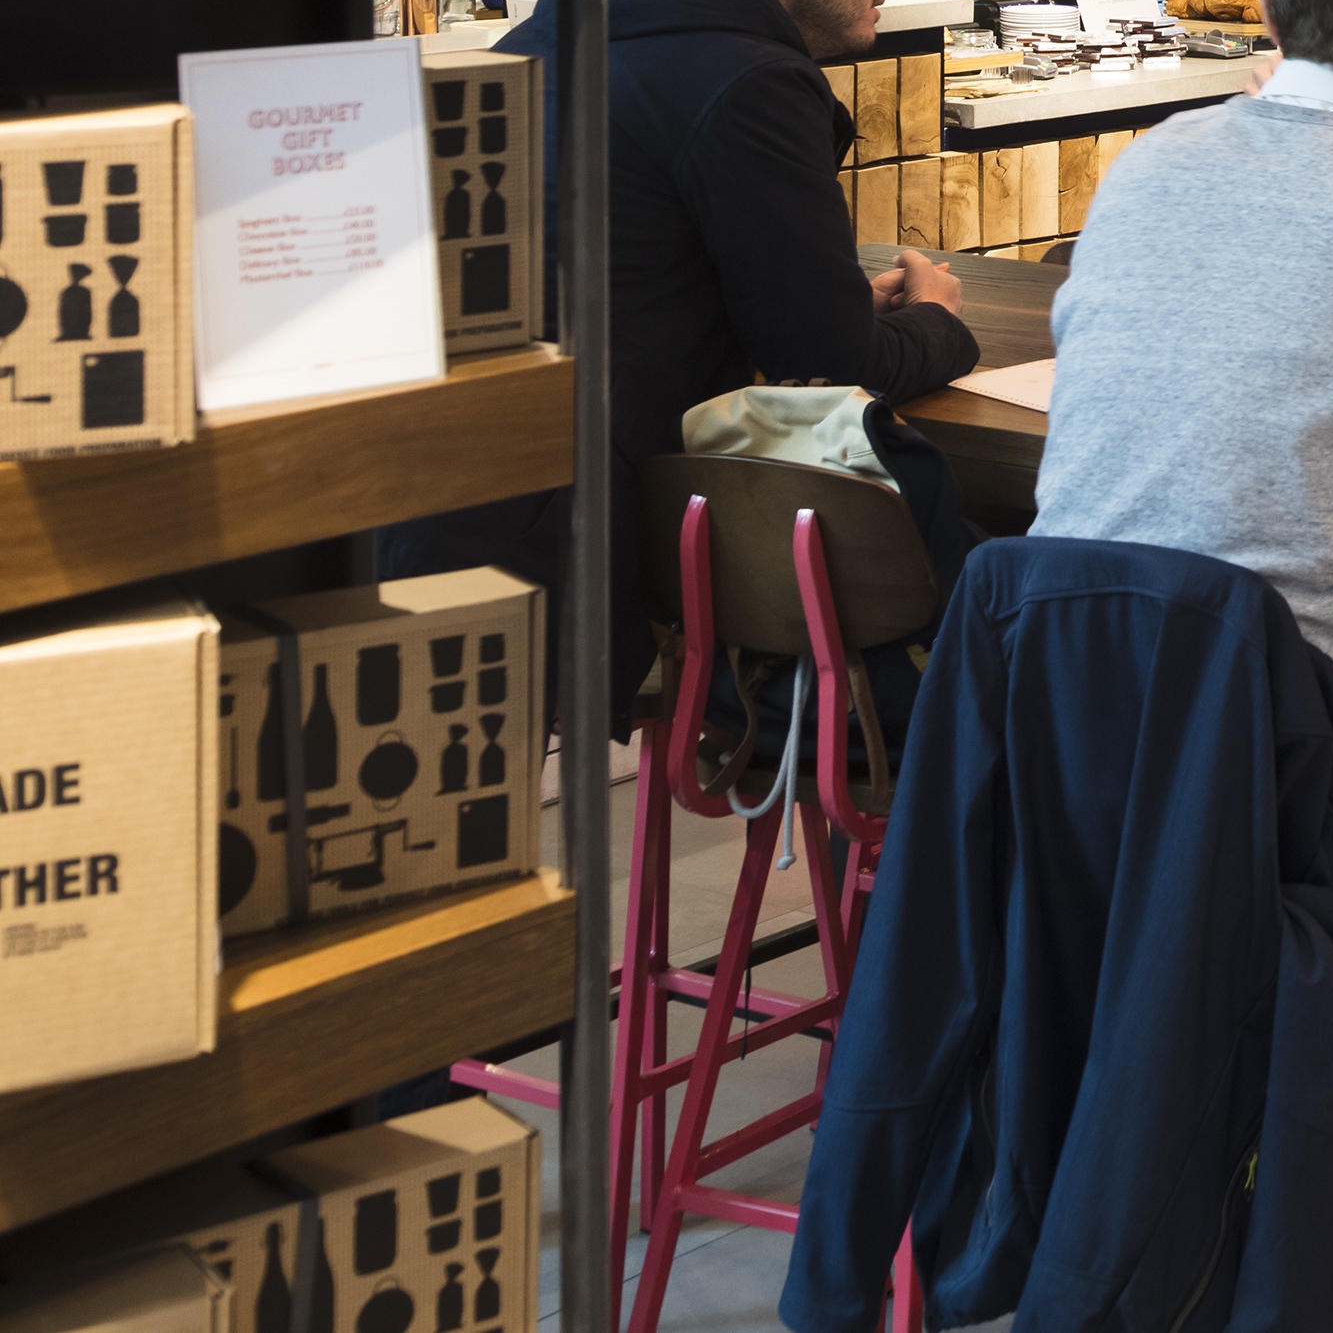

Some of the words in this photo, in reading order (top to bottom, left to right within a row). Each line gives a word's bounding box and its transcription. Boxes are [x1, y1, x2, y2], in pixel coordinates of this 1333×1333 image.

[248, 101, 363, 129] GOURMET
[281, 128, 334, 151] GIFT
[273, 151, 346, 176] BOXES
